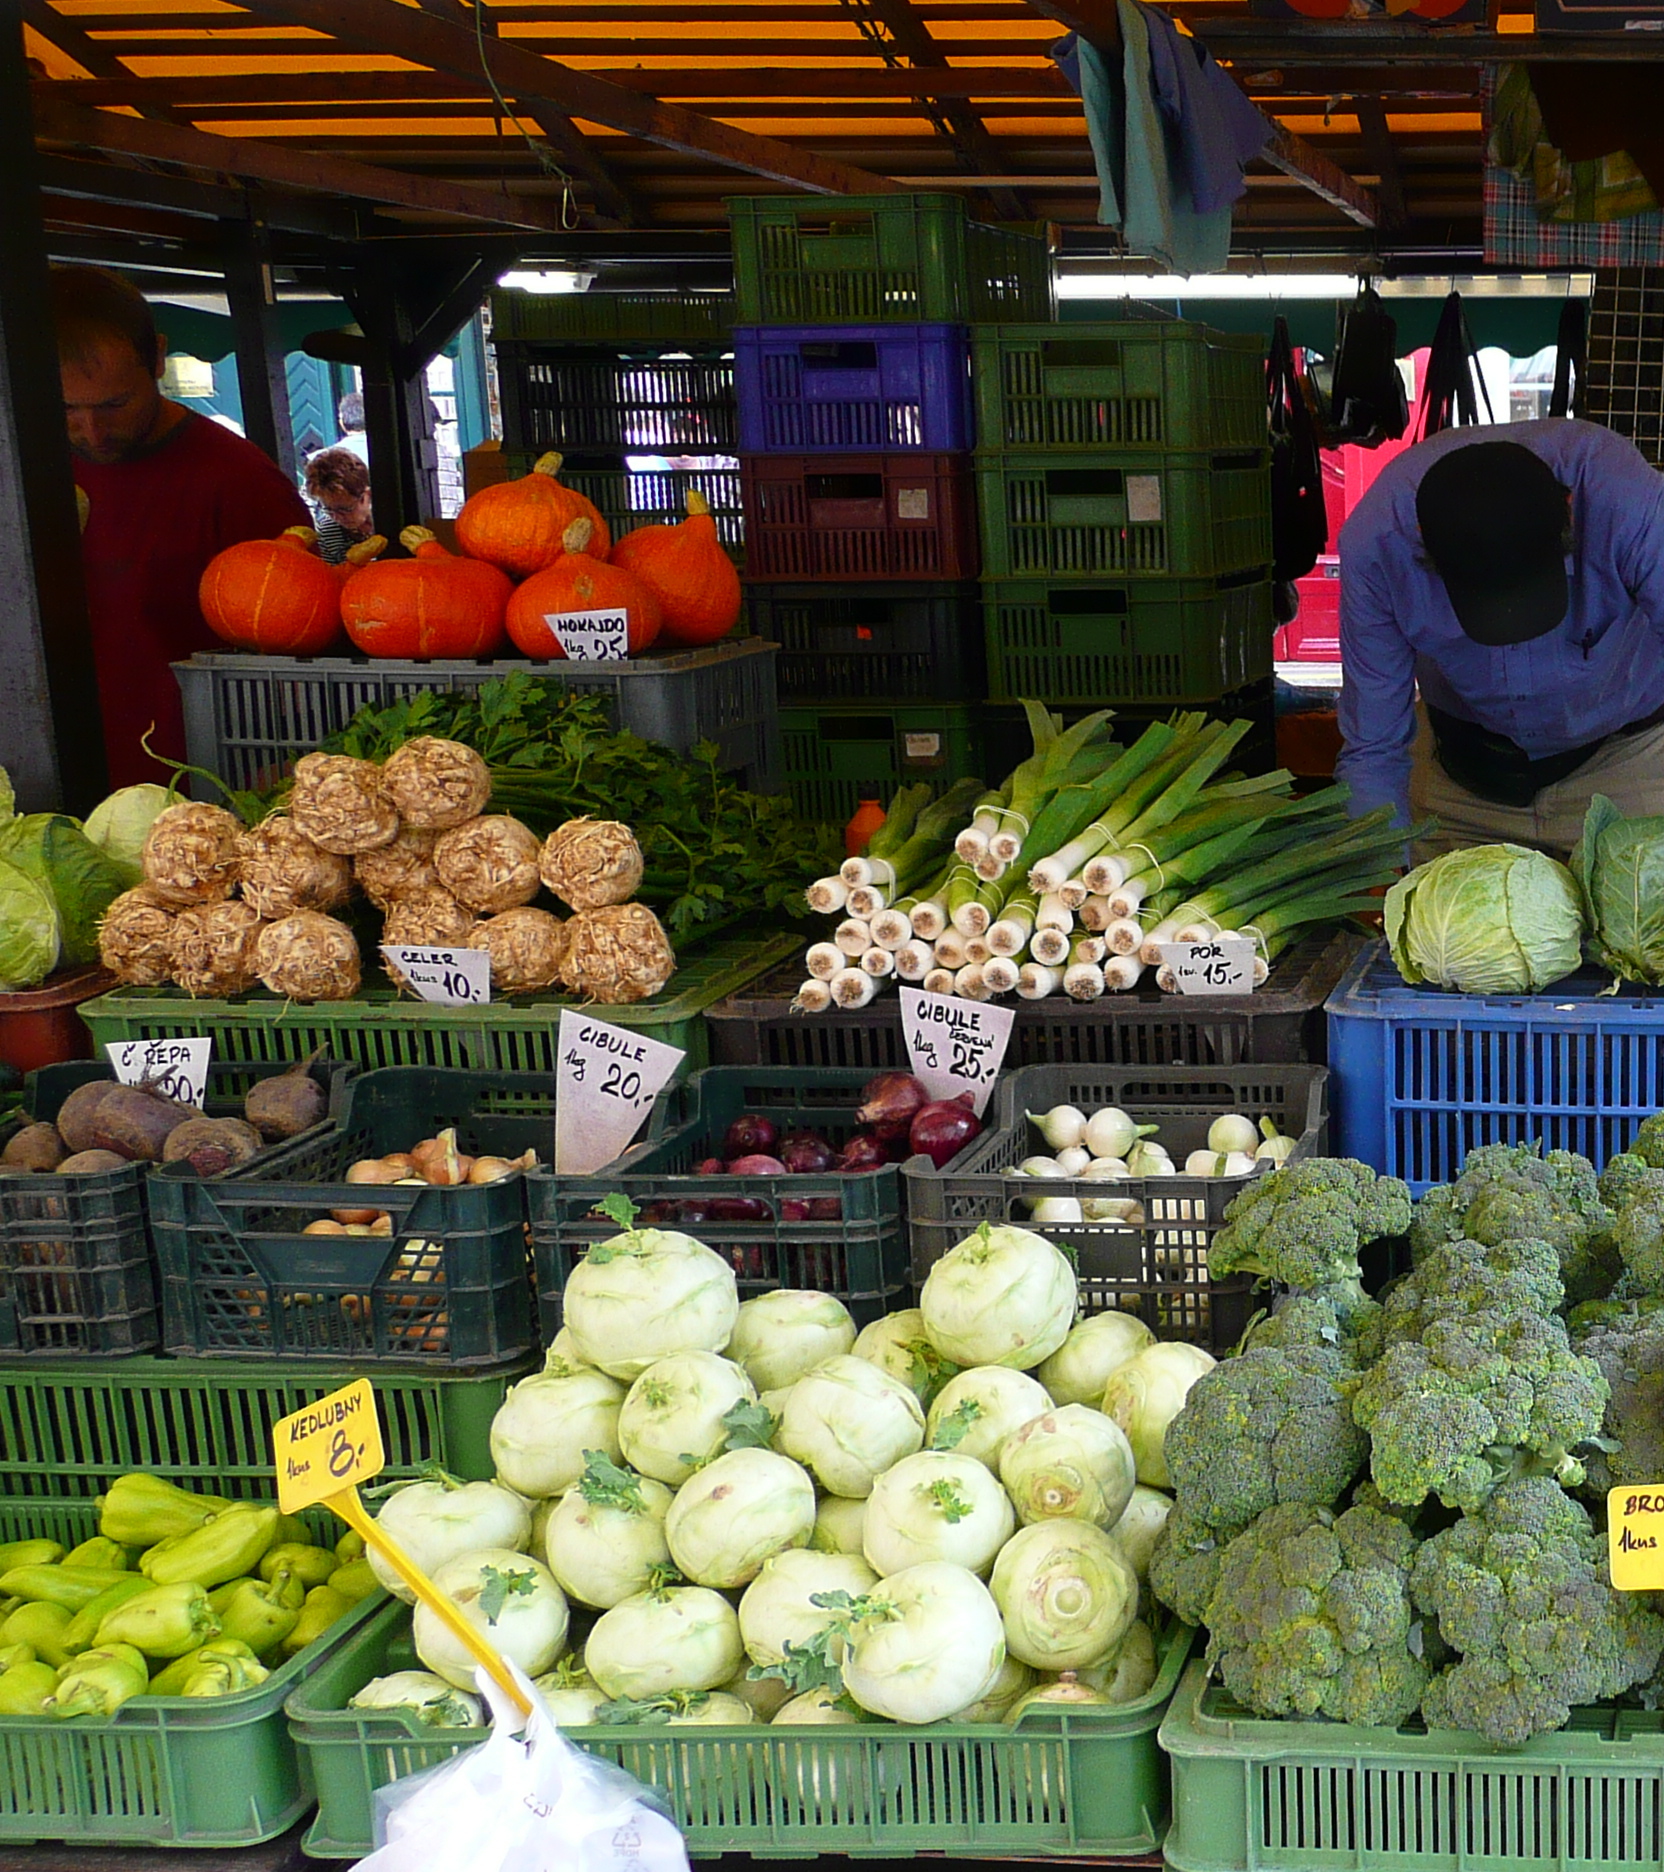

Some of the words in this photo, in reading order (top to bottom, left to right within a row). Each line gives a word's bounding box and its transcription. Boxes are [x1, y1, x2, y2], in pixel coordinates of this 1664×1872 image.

[401, 951, 458, 966] CELER
[1203, 962, 1243, 985] 15,-
[443, 970, 481, 1002] 10,-
[917, 1000, 980, 1031] CIBULE
[143, 1039, 191, 1065] ŘEPA
[579, 1026, 647, 1063] CIBULE
[913, 1029, 938, 1068] 1kg
[949, 1043, 995, 1084] 25,-
[564, 1048, 586, 1081] 1kg
[600, 1063, 654, 1109] 20,-
[290, 1391, 362, 1443] KEDLUBNY
[286, 1457, 311, 1480] 1kus
[329, 1429, 365, 1478] 8,-
[1618, 1526, 1657, 1553] 1kus
